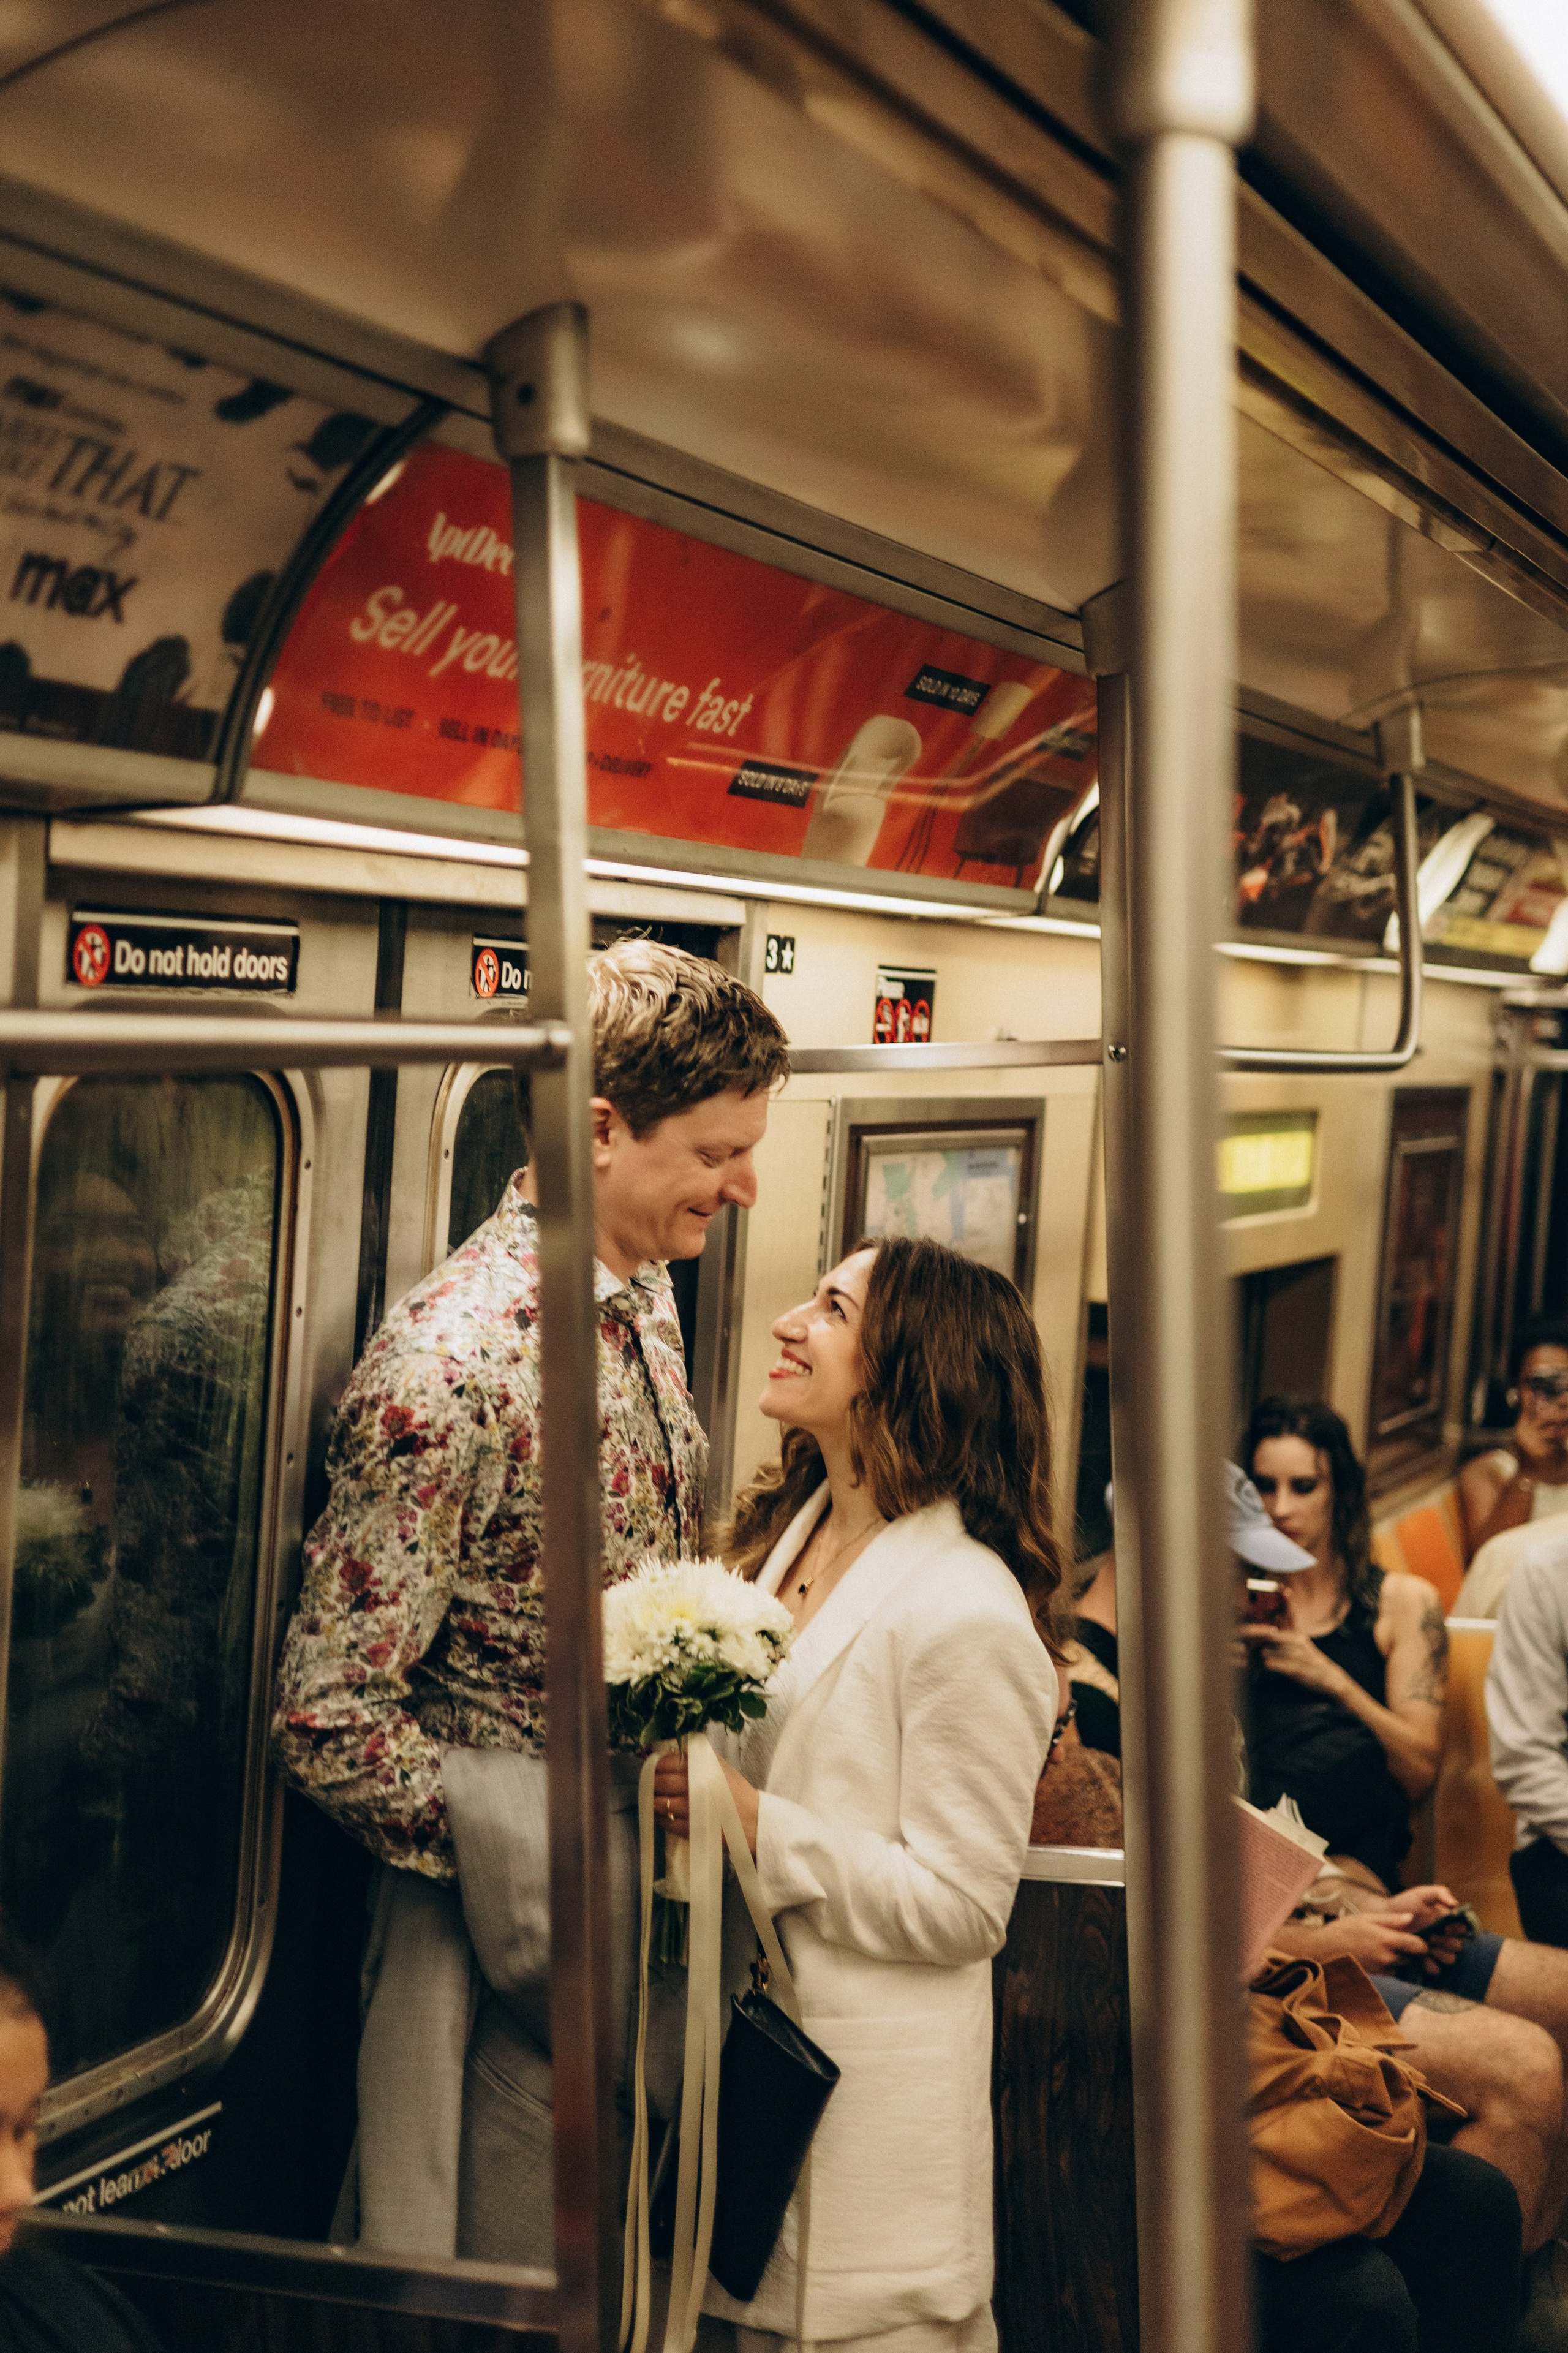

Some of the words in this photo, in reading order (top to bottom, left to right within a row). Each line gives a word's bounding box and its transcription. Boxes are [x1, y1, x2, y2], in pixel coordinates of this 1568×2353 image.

[47, 435, 203, 521] THAT
[9, 550, 141, 626] max
[349, 584, 459, 657] Sell
[685, 676, 754, 736] fast
[114, 939, 146, 975] Do
[149, 945, 183, 976] not
[186, 944, 231, 978] hold
[233, 947, 288, 981] doors
[501, 961, 522, 990] Do
